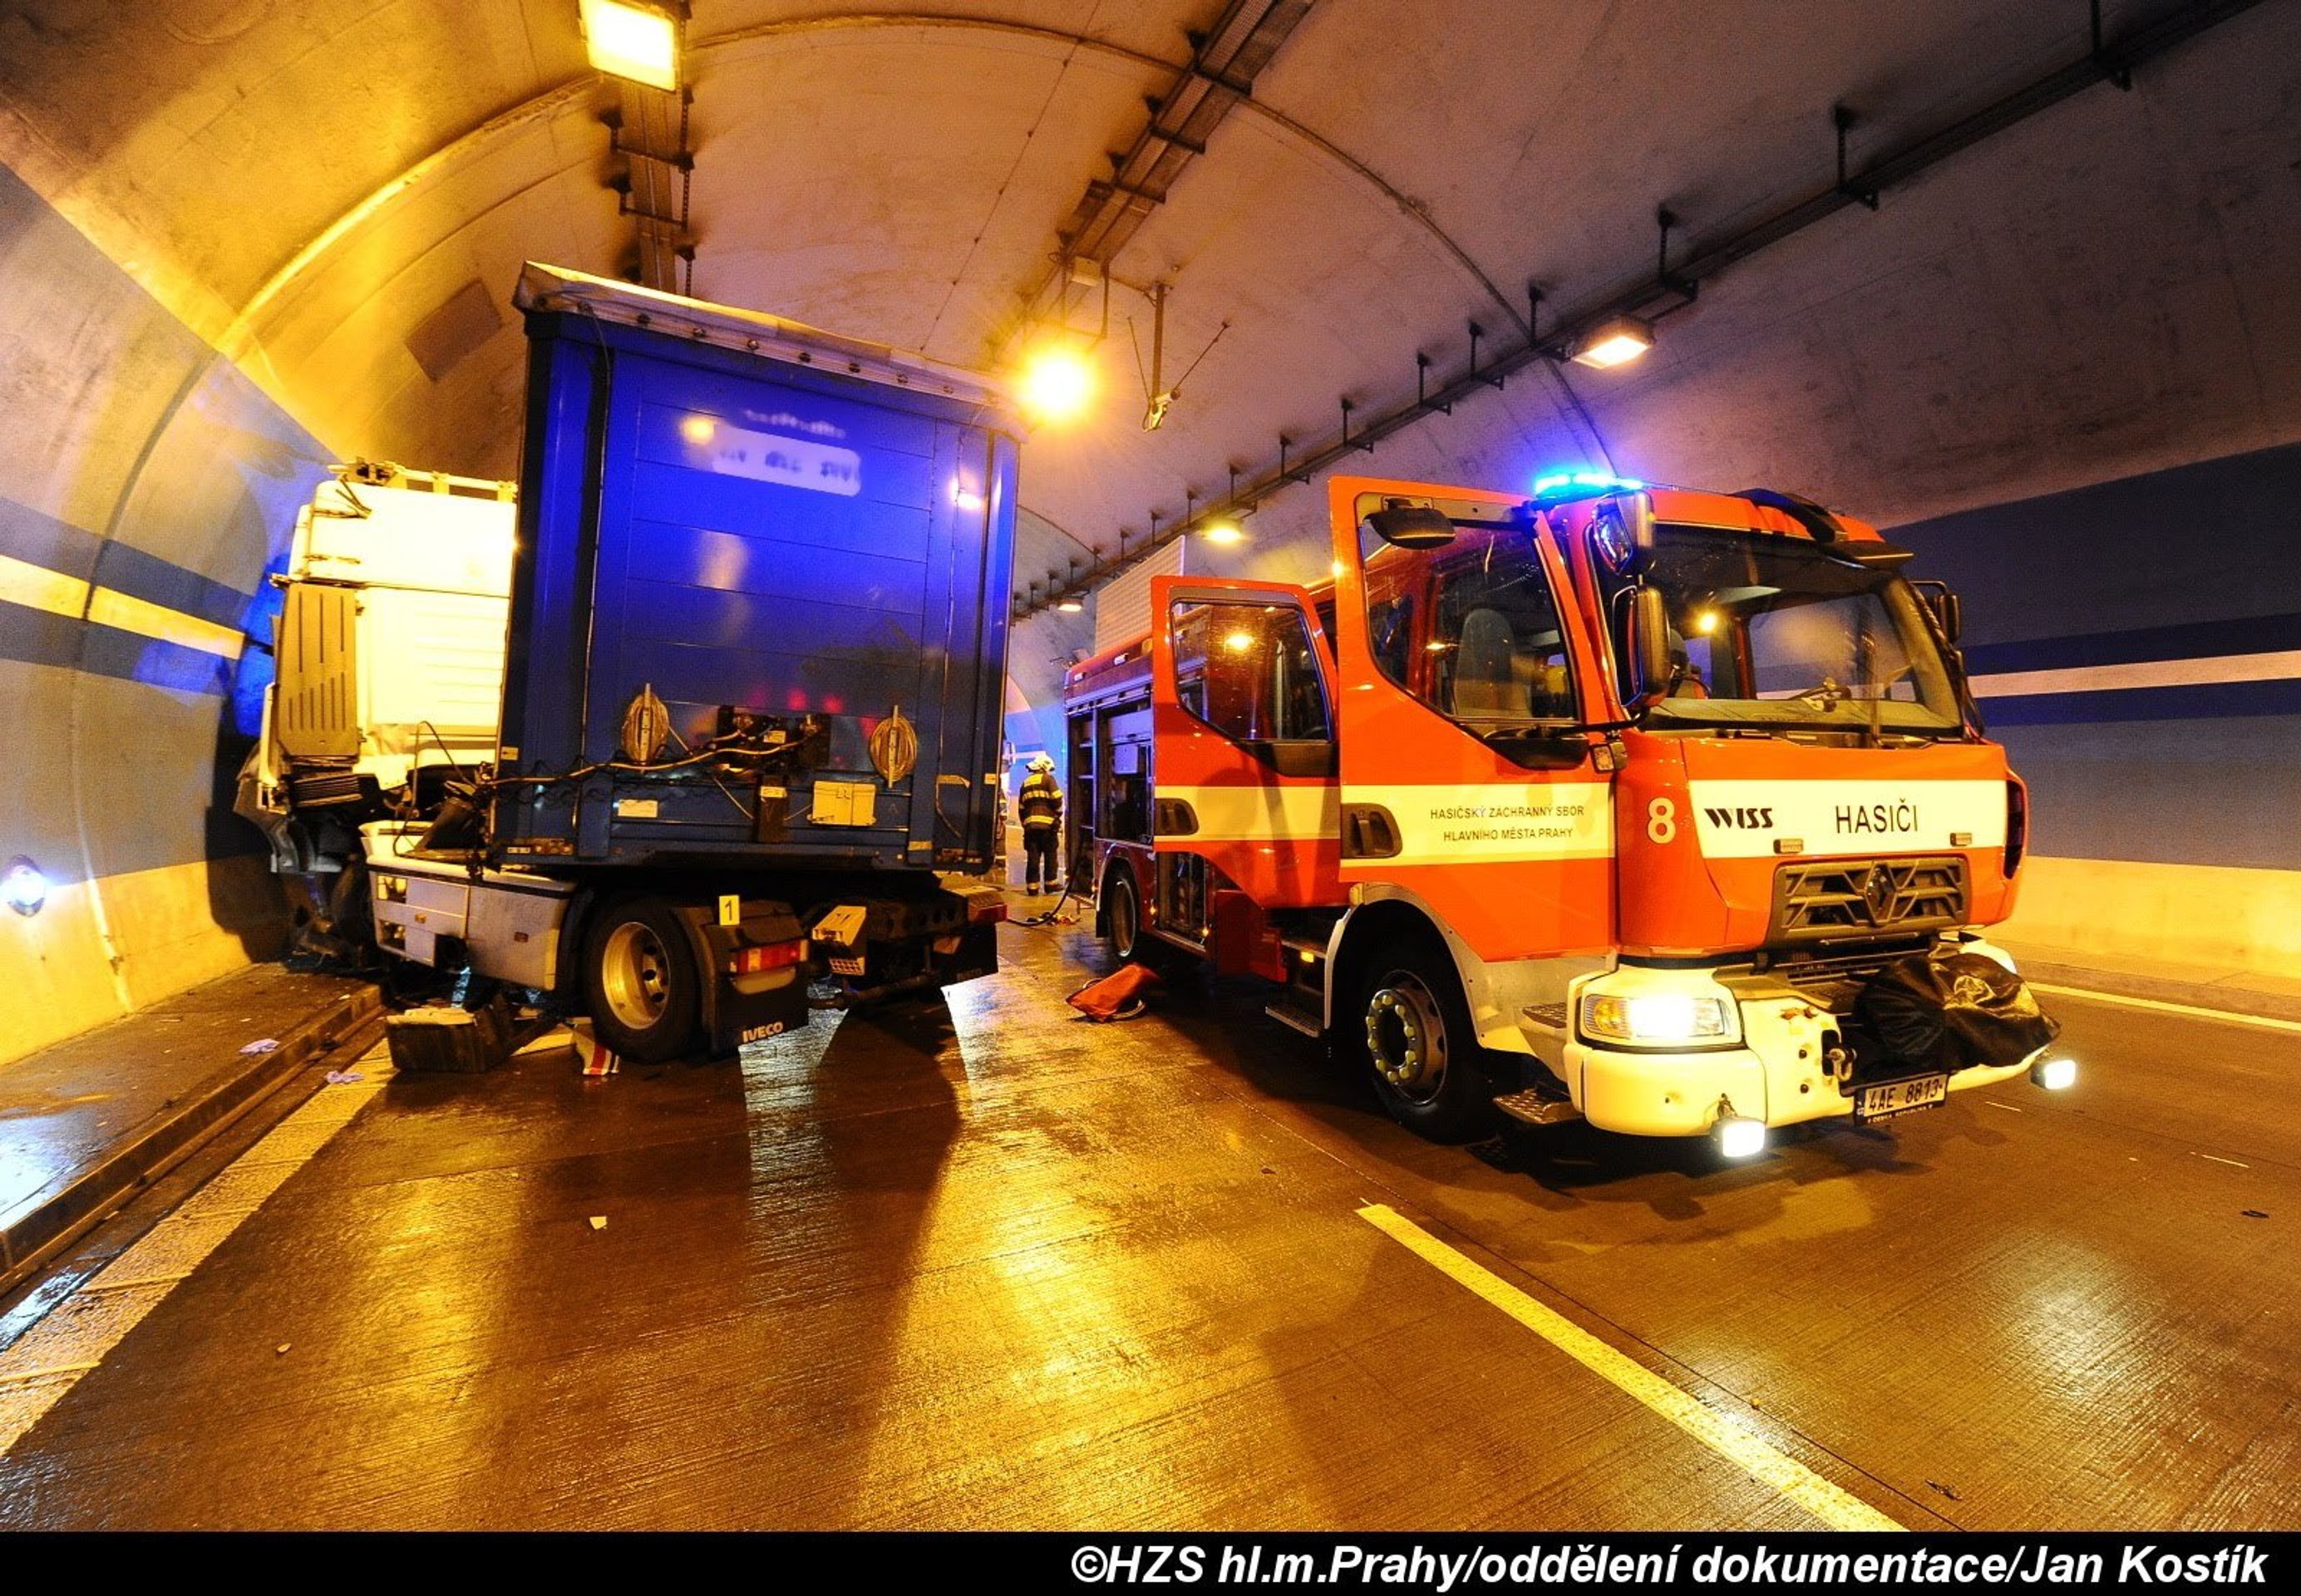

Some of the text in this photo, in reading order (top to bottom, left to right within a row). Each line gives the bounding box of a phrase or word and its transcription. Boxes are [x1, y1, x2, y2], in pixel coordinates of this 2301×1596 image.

[1430, 805, 1486, 820] HASIČSKÝ
[1555, 805, 1584, 816] SBOR
[1648, 797, 1676, 844] 8
[1704, 807, 1774, 830] WISS
[1835, 798, 1919, 834] HASIČI
[1443, 827, 1574, 842] HLAVNÍHO MĚSTA PRAHY
[724, 900, 732, 921] 1
[742, 1022, 784, 1042] IVECO
[1869, 1087, 1896, 1111] 4AE
